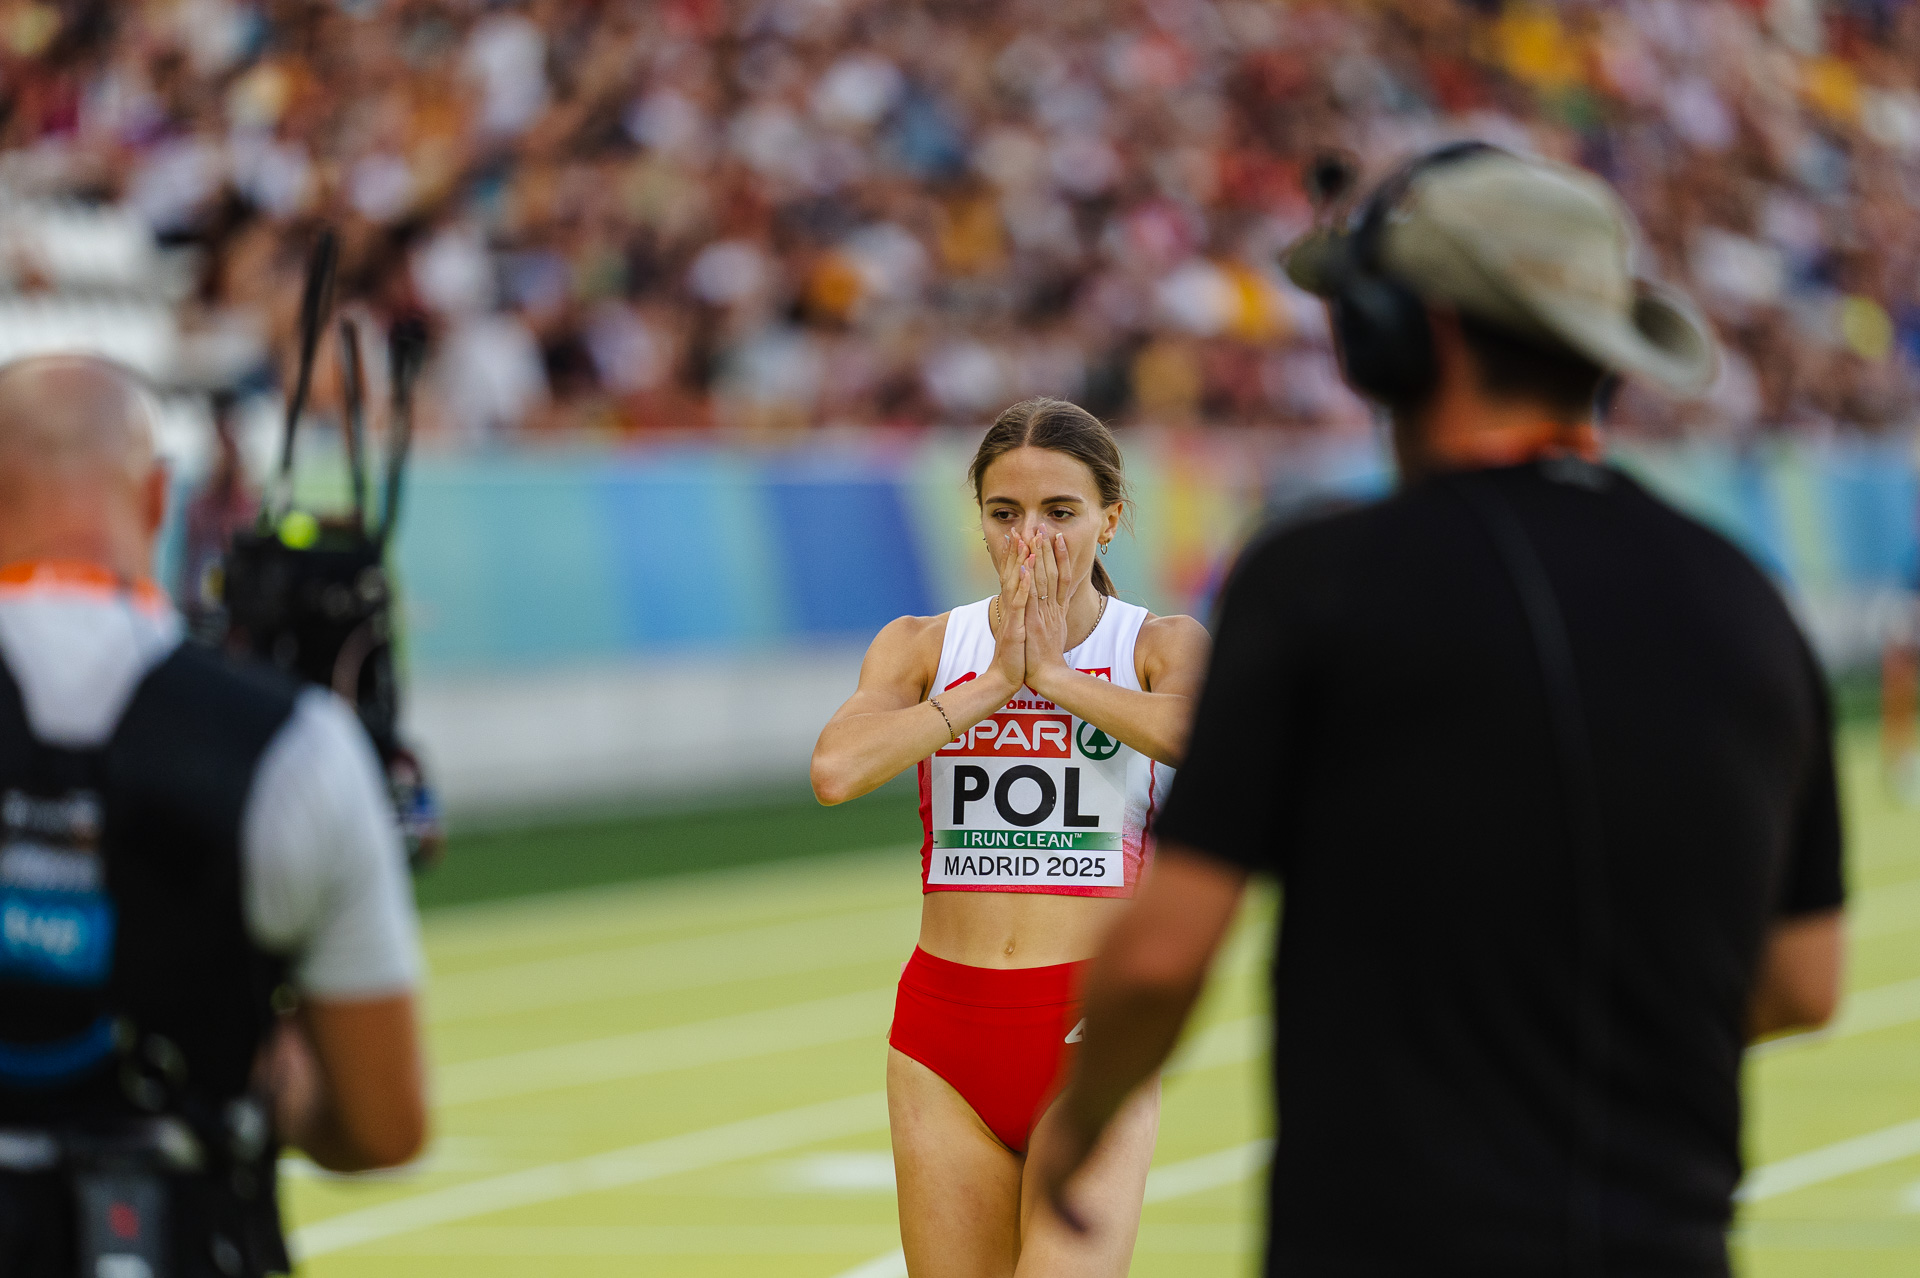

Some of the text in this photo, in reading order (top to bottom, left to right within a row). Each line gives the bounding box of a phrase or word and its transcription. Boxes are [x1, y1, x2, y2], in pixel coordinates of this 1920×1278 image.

[1006, 700, 1055, 710] ORLEN
[953, 765, 1100, 827] POL
[963, 832, 967, 846] I
[971, 832, 1008, 846] RUN
[945, 856, 1106, 877] MADRID 2025
